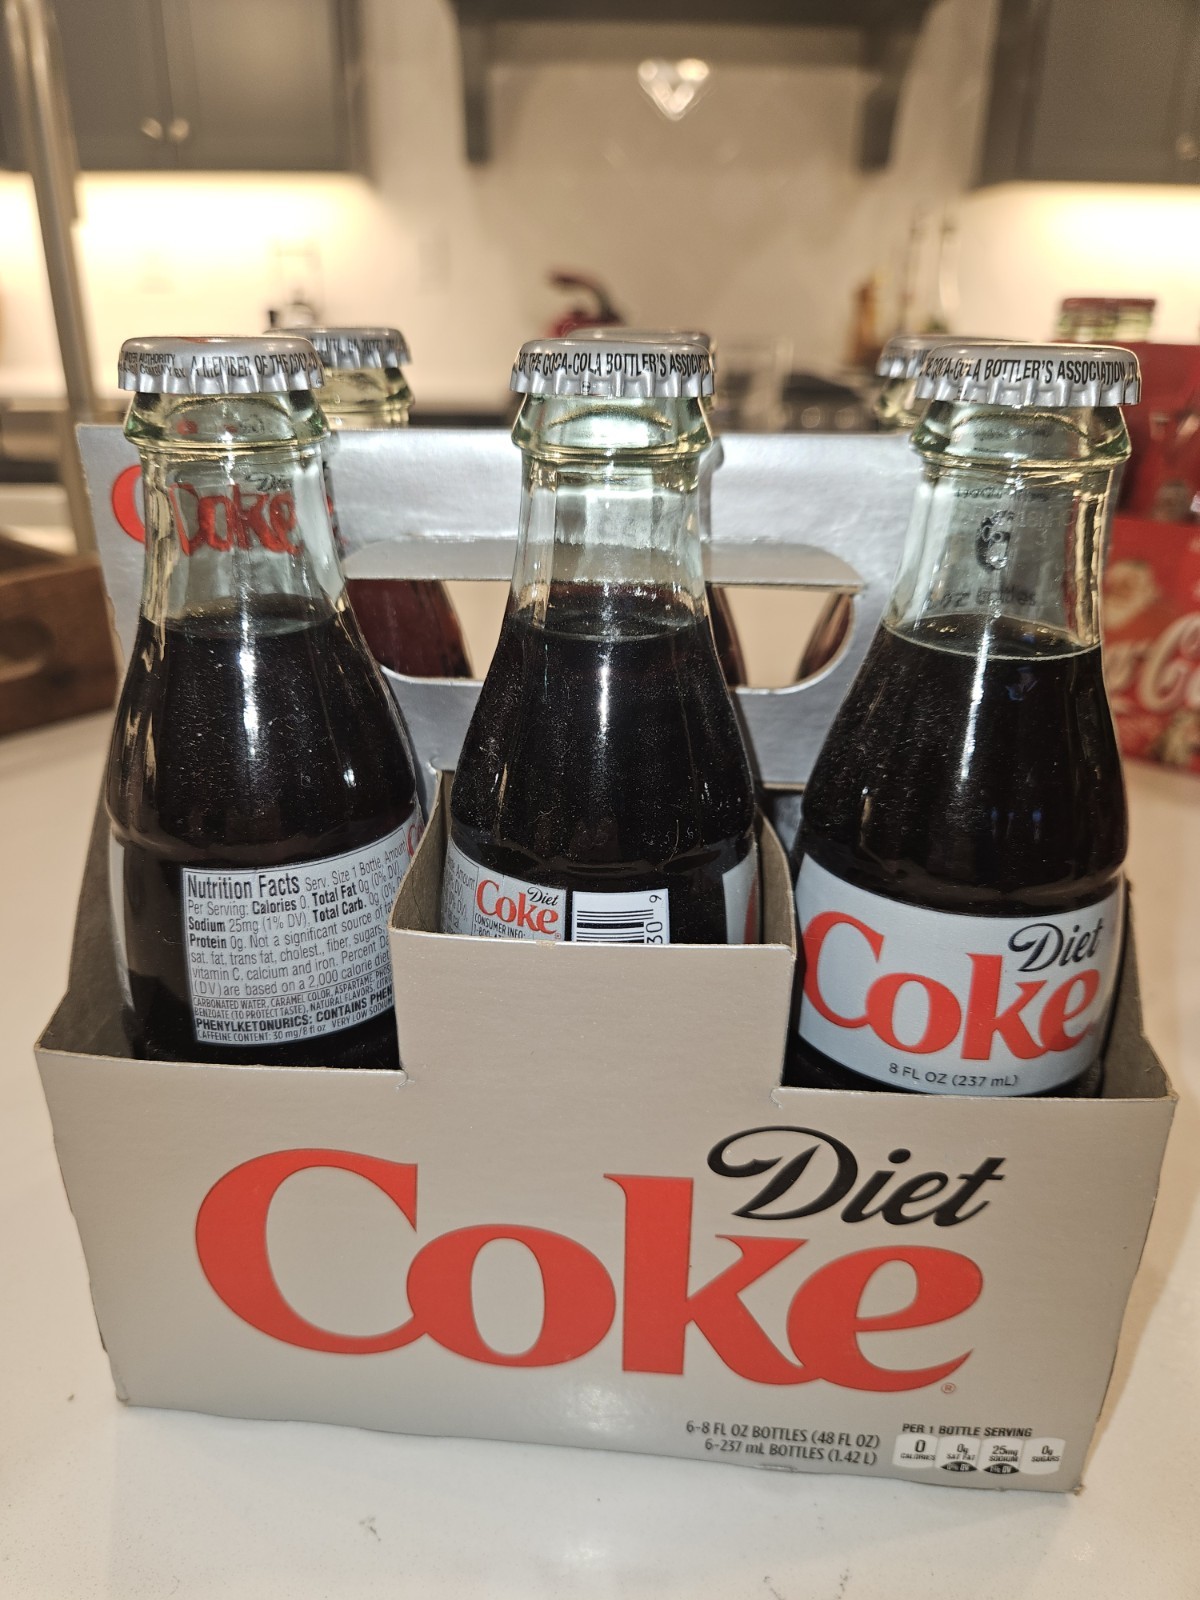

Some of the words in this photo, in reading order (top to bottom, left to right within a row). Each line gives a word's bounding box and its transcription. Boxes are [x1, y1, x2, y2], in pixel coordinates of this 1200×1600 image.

[139, 353, 176, 366] AUTHORITY
[190, 355, 200, 376] A
[202, 356, 252, 378] MEMBER
[254, 354, 270, 376] OF
[269, 354, 289, 376] THE
[529, 352, 543, 374] THE
[542, 352, 602, 377] COCA-COLA
[606, 352, 666, 378] BOTTLER'S
[984, 359, 1054, 384] BOTTLER'S
[188, 874, 252, 900] Nutrition
[258, 873, 300, 898] Facts
[306, 876, 330, 892] Serv.
[332, 870, 350, 886] Size
[352, 866, 358, 878] 1
[188, 900, 204, 915] Per
[207, 901, 249, 919] Serving:
[252, 898, 297, 915] Calories
[312, 887, 338, 907] Total
[341, 882, 358, 900] Fat
[358, 879, 370, 894] 0g
[372, 871, 386, 889] (0%
[476, 880, 559, 935] Coke
[527, 886, 559, 907] Diet
[188, 916, 226, 932] Sodium
[229, 918, 259, 935] 25mg
[262, 916, 284, 932] (1%
[312, 903, 339, 923] Total
[342, 898, 367, 916] Carb.
[368, 892, 380, 907] 0g
[475, 912, 506, 935] CONSUMER
[508, 926, 526, 938] INFO:
[189, 933, 228, 949] Protein
[230, 936, 246, 952] 0g.
[250, 934, 269, 949] Not
[274, 936, 280, 947] a
[284, 922, 338, 947] significant
[342, 912, 372, 933] source
[375, 904, 383, 920] of
[1008, 917, 1103, 972] Diet
[192, 966, 230, 981] vitamin
[246, 966, 288, 980] calcium
[292, 960, 312, 976] and
[315, 957, 339, 972] iron.
[341, 942, 376, 964] Percent
[230, 952, 258, 966] trans
[245, 981, 278, 996] based
[281, 981, 296, 994] on
[298, 979, 305, 990] a
[308, 968, 339, 990] 2,000
[341, 958, 372, 980] calorie
[802, 910, 1100, 1061] Coke
[194, 996, 239, 1010] CARBONATED
[270, 994, 306, 1008] CARAMEL
[194, 1006, 228, 1019] BENZOATE
[230, 1010, 244, 1020] (TO
[246, 1008, 278, 1020] PROTECT
[310, 996, 343, 1012] NATURAL
[196, 1014, 313, 1032] PHENYLKETONURICS:
[316, 998, 368, 1023] CONTAINS
[198, 1030, 232, 1040] CAFFEINE
[234, 1032, 272, 1042] CONTENT:
[273, 1030, 284, 1040] 30
[285, 1026, 308, 1038] mg/8
[317, 1024, 326, 1032] oz
[331, 1016, 351, 1028] VERY
[352, 1009, 368, 1023] LOW
[889, 1062, 899, 1075] 8
[902, 1067, 920, 1082] FL
[925, 1071, 948, 1086] OZ
[952, 1074, 987, 1088] (237
[990, 1074, 1020, 1088] mL)
[707, 1125, 1007, 1228] Diet
[195, 1147, 984, 1393] Coke
[686, 1420, 710, 1434] 6-8
[714, 1422, 727, 1436] FL
[731, 1423, 749, 1438] OZ
[752, 1425, 808, 1443] BOTTLES
[811, 1428, 836, 1445] (48
[838, 1432, 852, 1448] FL
[856, 1434, 882, 1450] OZ)
[902, 1423, 925, 1434] PER
[938, 1425, 981, 1437] BOTTLE
[984, 1426, 1033, 1438] SERVING
[704, 1438, 743, 1454] 6-237
[745, 1442, 765, 1456] mL
[768, 1442, 825, 1461] BOTTLES
[828, 1448, 861, 1465] (1.42
[863, 1451, 878, 1466] L)
[914, 1439, 927, 1454] 0
[956, 1443, 970, 1455] 0g
[992, 1444, 1018, 1457] 25mg
[1030, 1455, 1061, 1464] SUGARS
[1041, 1444, 1054, 1456] 0g
